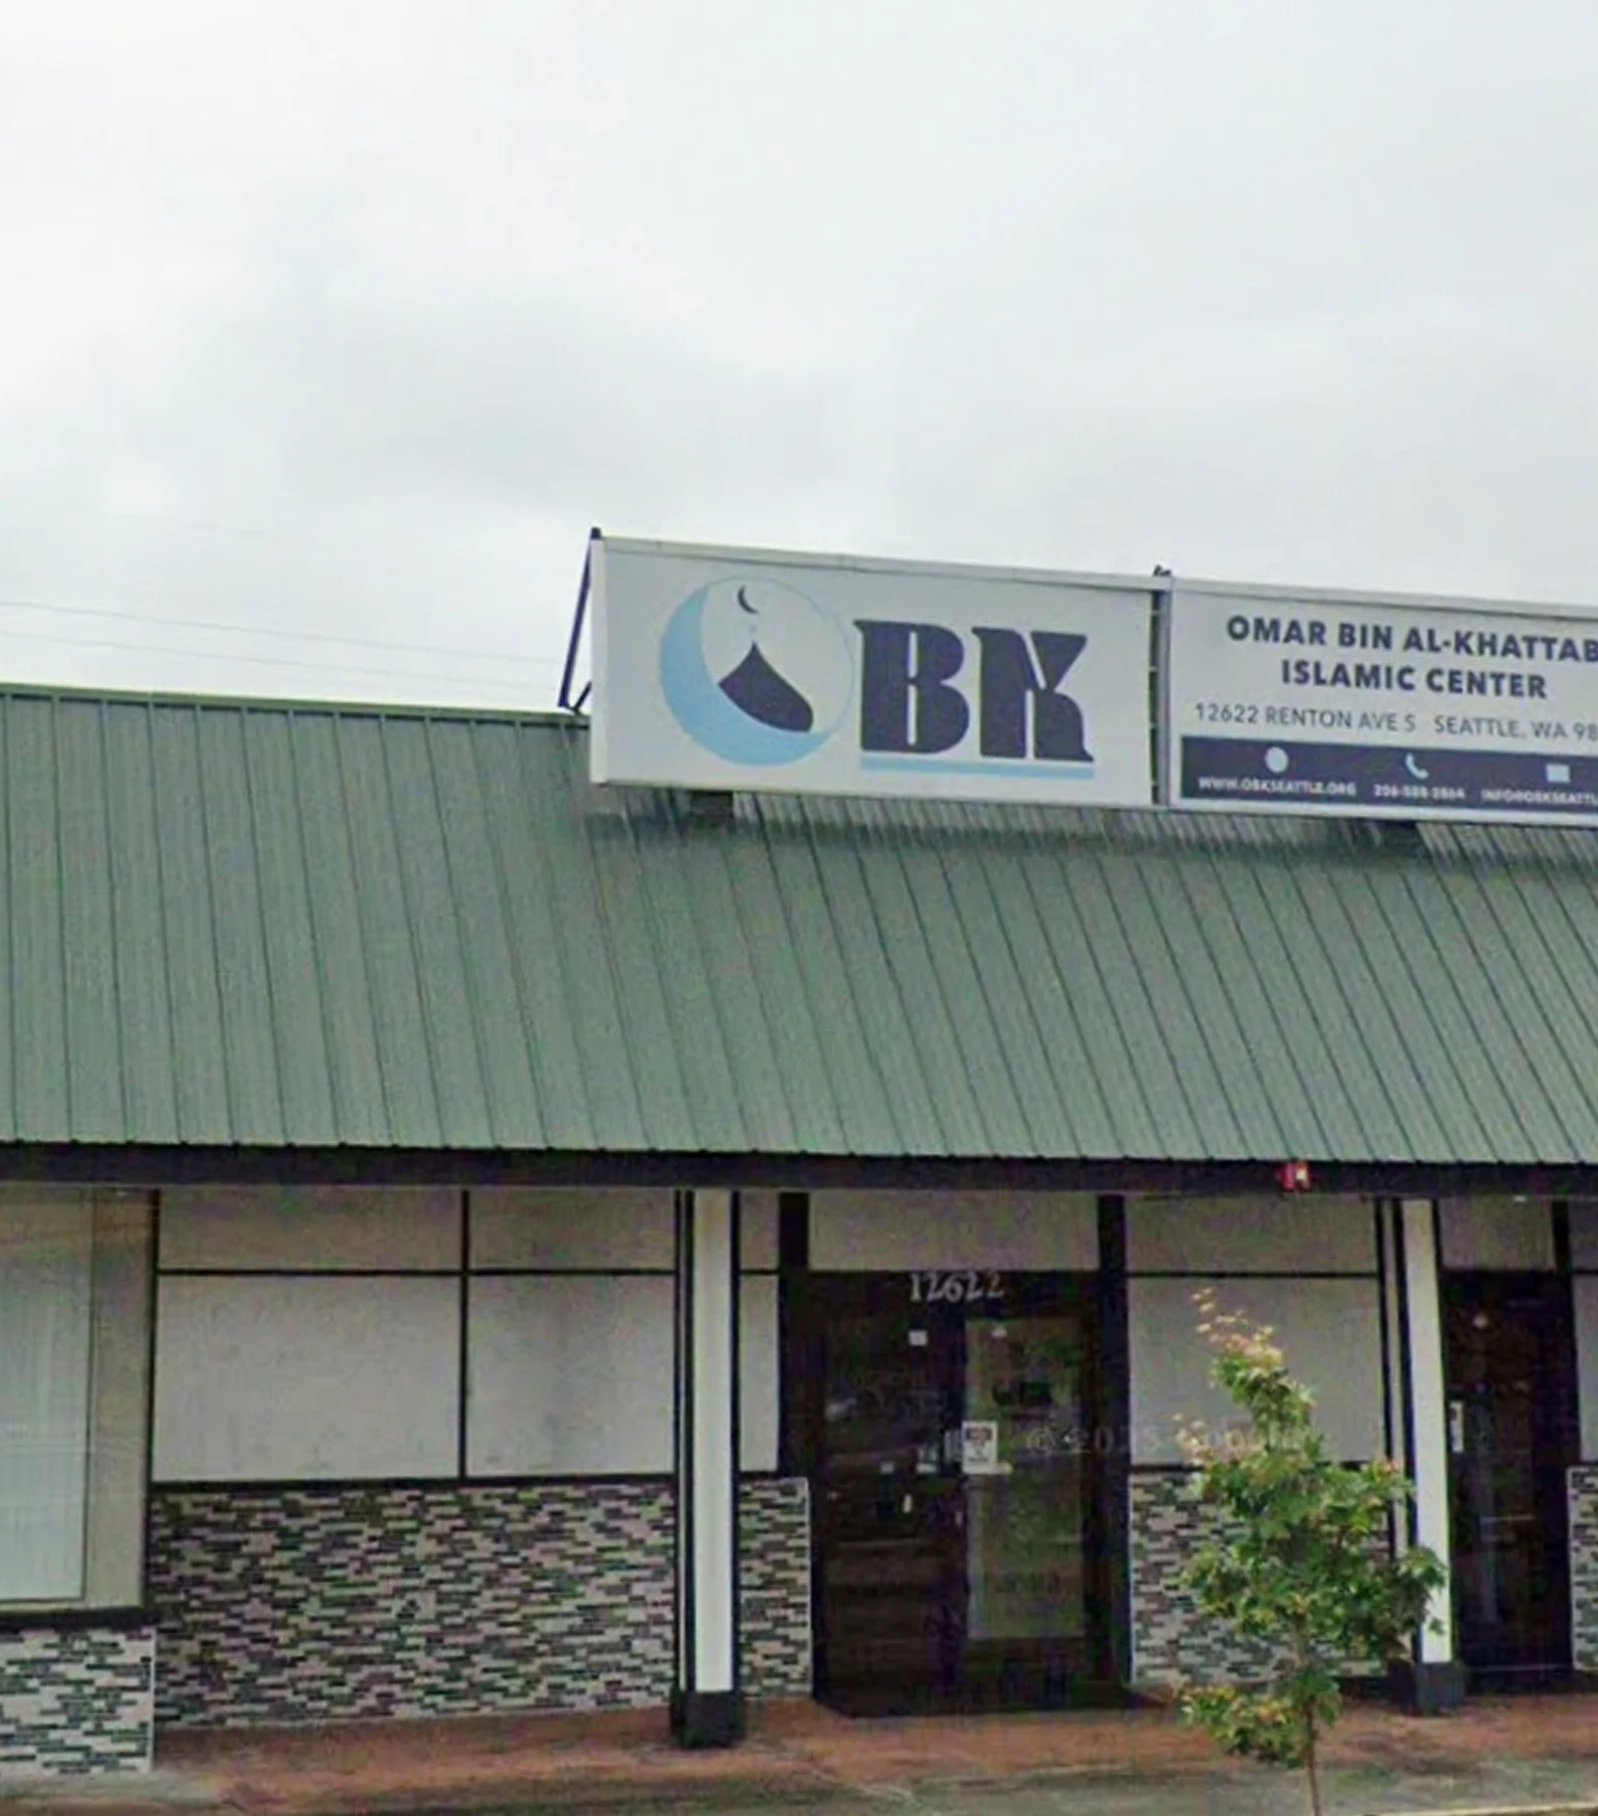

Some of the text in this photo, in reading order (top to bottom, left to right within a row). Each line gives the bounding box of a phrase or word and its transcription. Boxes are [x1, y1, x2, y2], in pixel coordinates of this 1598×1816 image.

[1227, 615, 1327, 646] OMAR
[1338, 622, 1392, 650] BIN
[1282, 659, 1547, 699] ISLAMIC CENTER
[1196, 703, 1259, 724] 12622
[1265, 706, 1352, 728] RENTON
[1358, 712, 1398, 731] AVE
[1404, 714, 1416, 732] S
[1531, 722, 1568, 739] WA
[909, 1268, 1005, 1302] 12622
